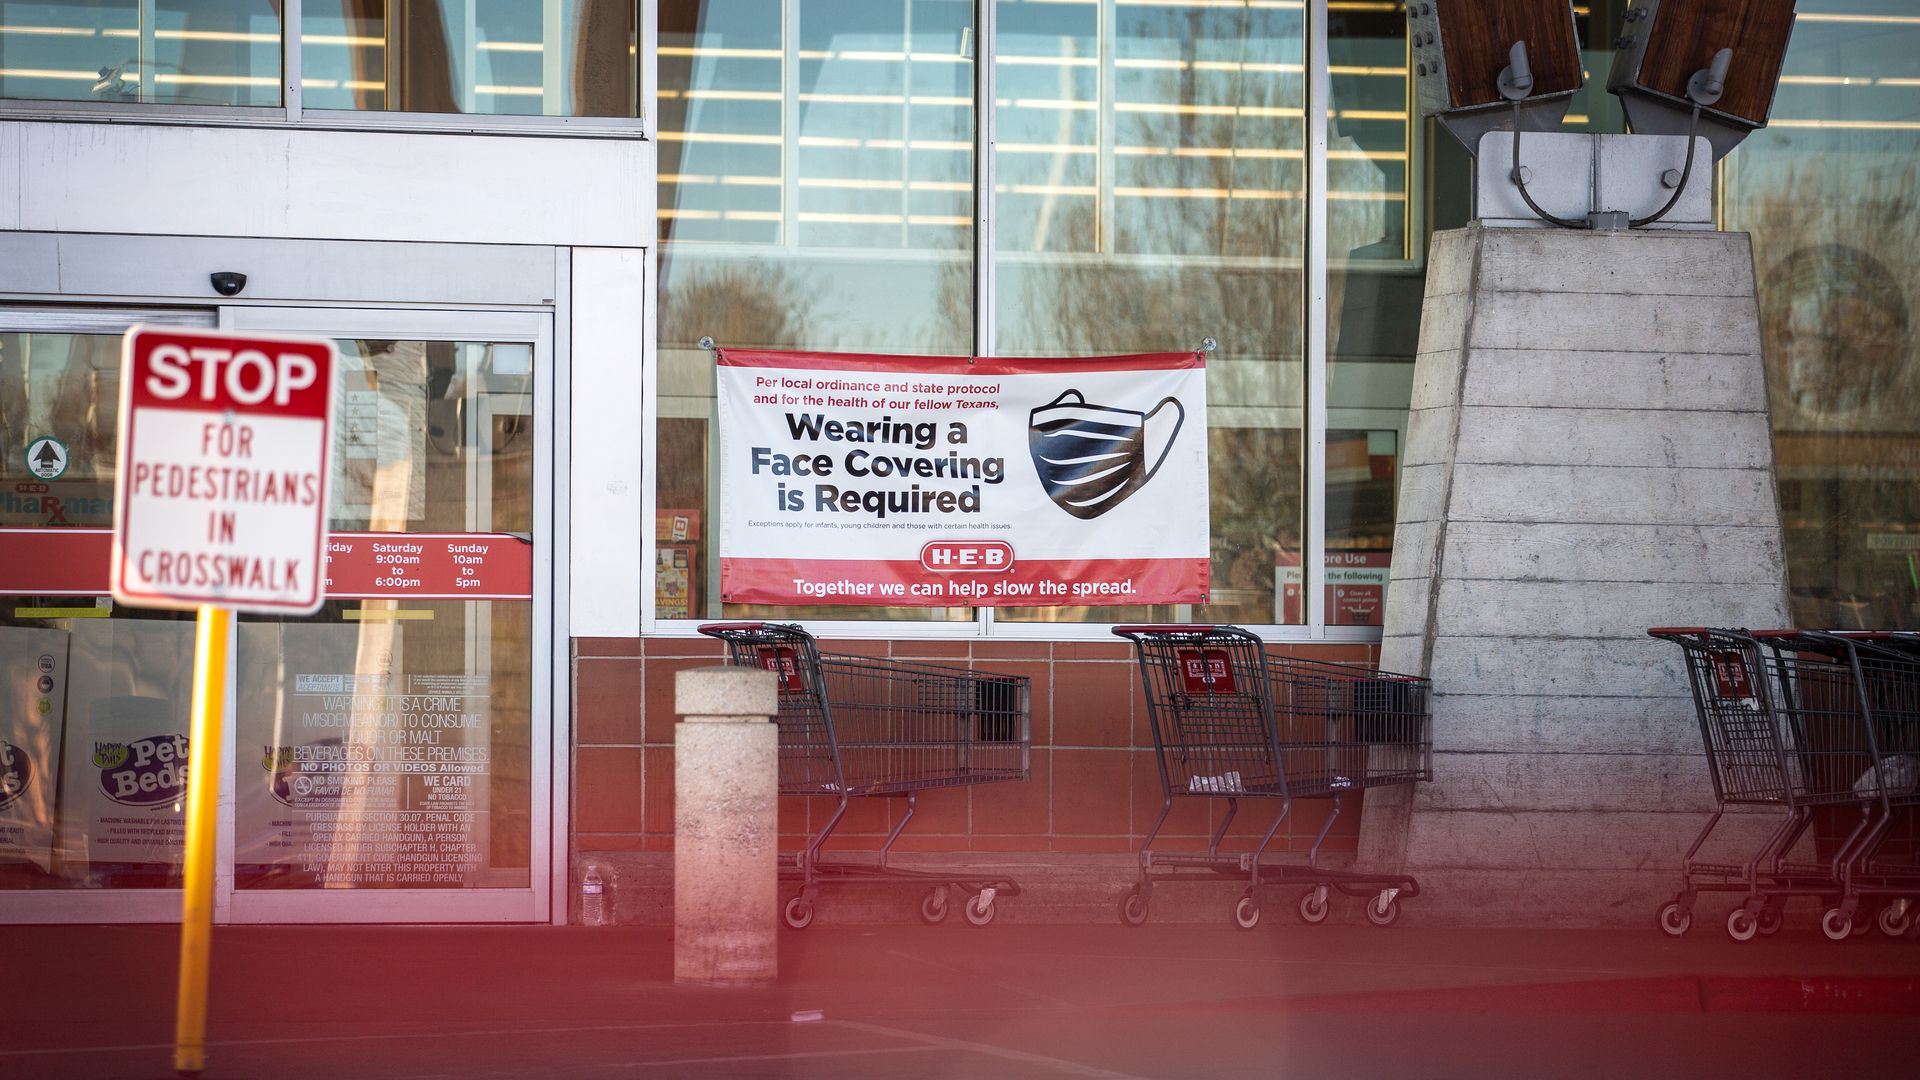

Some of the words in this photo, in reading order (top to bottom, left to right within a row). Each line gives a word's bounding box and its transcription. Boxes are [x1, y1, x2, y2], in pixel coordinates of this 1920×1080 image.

[146, 343, 317, 406] STOP
[756, 376, 778, 388] Per
[781, 377, 812, 389] local
[816, 379, 881, 392] ordinance
[884, 382, 908, 393] and
[912, 383, 944, 394] state
[947, 384, 1000, 396] protocol
[753, 394, 778, 404] and
[781, 394, 799, 405] for
[803, 395, 824, 406] the
[827, 396, 868, 408] health
[872, 398, 886, 408] of
[889, 400, 911, 410] our
[914, 399, 952, 410] fellow
[956, 400, 999, 410] Texans,
[784, 412, 937, 450] Wearing
[947, 421, 968, 445] a
[201, 422, 254, 458] FOR
[751, 446, 834, 477] Face
[844, 449, 1005, 485] Covering
[134, 462, 318, 507] PEDESTRIANS
[778, 481, 805, 512] is
[815, 483, 981, 519] Required
[207, 511, 236, 544] IN
[748, 519, 784, 529] Exceptions
[785, 521, 802, 529] apply
[804, 520, 813, 528] for
[841, 522, 862, 530] young
[863, 521, 890, 529] children
[925, 522, 942, 530] with
[944, 522, 967, 530] certain
[969, 522, 990, 530] health
[372, 543, 423, 554] Saturday
[447, 543, 489, 555] Sunday
[375, 555, 420, 564] 9:00am
[453, 555, 483, 565] 10am
[932, 548, 1005, 565] H-E-B
[1324, 555, 1342, 564] ore
[1345, 553, 1366, 564] Use
[138, 550, 301, 592] CROSSWALK
[392, 567, 404, 576] to
[462, 567, 474, 576] to
[1328, 572, 1341, 580] the
[1343, 572, 1383, 581] following
[375, 577, 421, 588] 6:00pm
[455, 578, 481, 588] 5pm
[792, 578, 873, 597] Together
[879, 582, 905, 596] we
[910, 582, 943, 596] can
[949, 580, 988, 599] help
[993, 579, 1035, 596] slow
[1038, 579, 1067, 595] the
[1071, 578, 1136, 598] spread.
[298, 675, 311, 683] WE
[312, 675, 340, 683] ACCEPT
[400, 697, 410, 711] IS
[411, 697, 421, 711] A
[423, 697, 461, 712] CRIME
[302, 712, 399, 729] (MISDEMEANOR)
[402, 713, 418, 728] TO
[421, 713, 481, 728] CONSUME
[342, 729, 386, 744] LIQUOR
[389, 730, 407, 745] OR
[409, 730, 443, 745] MALT
[131, 734, 190, 767] Pet
[293, 745, 364, 761] BEVERAGES
[366, 746, 384, 761] ON
[385, 746, 425, 761] THESE
[427, 746, 489, 761] PREMISES.
[301, 762, 318, 772] NO
[321, 763, 370, 772] PHOTOS
[373, 763, 390, 772] OR
[393, 763, 437, 773] VIDEOS
[440, 763, 484, 773] Allowed
[313, 776, 325, 785] NO
[327, 776, 365, 786] SMOKING
[367, 776, 397, 785] PLEASE
[423, 775, 440, 787] WE
[442, 775, 471, 787] CARD
[314, 786, 340, 796] FAVOR
[341, 786, 352, 796] DE
[353, 786, 366, 796] NO
[427, 793, 437, 801] NO
[438, 793, 467, 801] TOBACCO
[363, 813, 398, 822] SECTION
[425, 813, 451, 822] PENAL
[453, 813, 476, 822] CODE
[309, 822, 354, 833] (TRESPASS
[368, 823, 402, 832] LICENSE
[404, 823, 436, 832] HOLDER
[437, 823, 458, 832] WITH
[460, 823, 471, 832] AN
[312, 832, 344, 842] OPENLY
[382, 833, 427, 844] HANDGUN),
[427, 833, 434, 842] A
[435, 833, 468, 842] PERSON
[303, 842, 343, 852] LICENSED
[345, 843, 373, 852] UNDER
[374, 843, 428, 852] SUBCHAPTER
[429, 843, 438, 853] H,
[440, 843, 476, 852] CHAPTER
[316, 852, 371, 862] GOVERNMENT
[373, 853, 394, 862] CODE
[397, 853, 439, 863] (HANDGUN
[441, 853, 483, 862] LICENSING
[327, 863, 347, 872] MAY
[347, 863, 363, 872] NOT
[365, 863, 392, 872] ENTER
[393, 863, 412, 872] THIS
[413, 863, 455, 872] PROPERTY
[456, 864, 477, 872] WITH
[314, 873, 322, 882] A
[323, 873, 363, 882] HANDGUN
[364, 873, 384, 882] THAT
[386, 873, 395, 882] IS
[396, 873, 431, 882] CARRIED
[432, 873, 464, 882] OPENLY.
